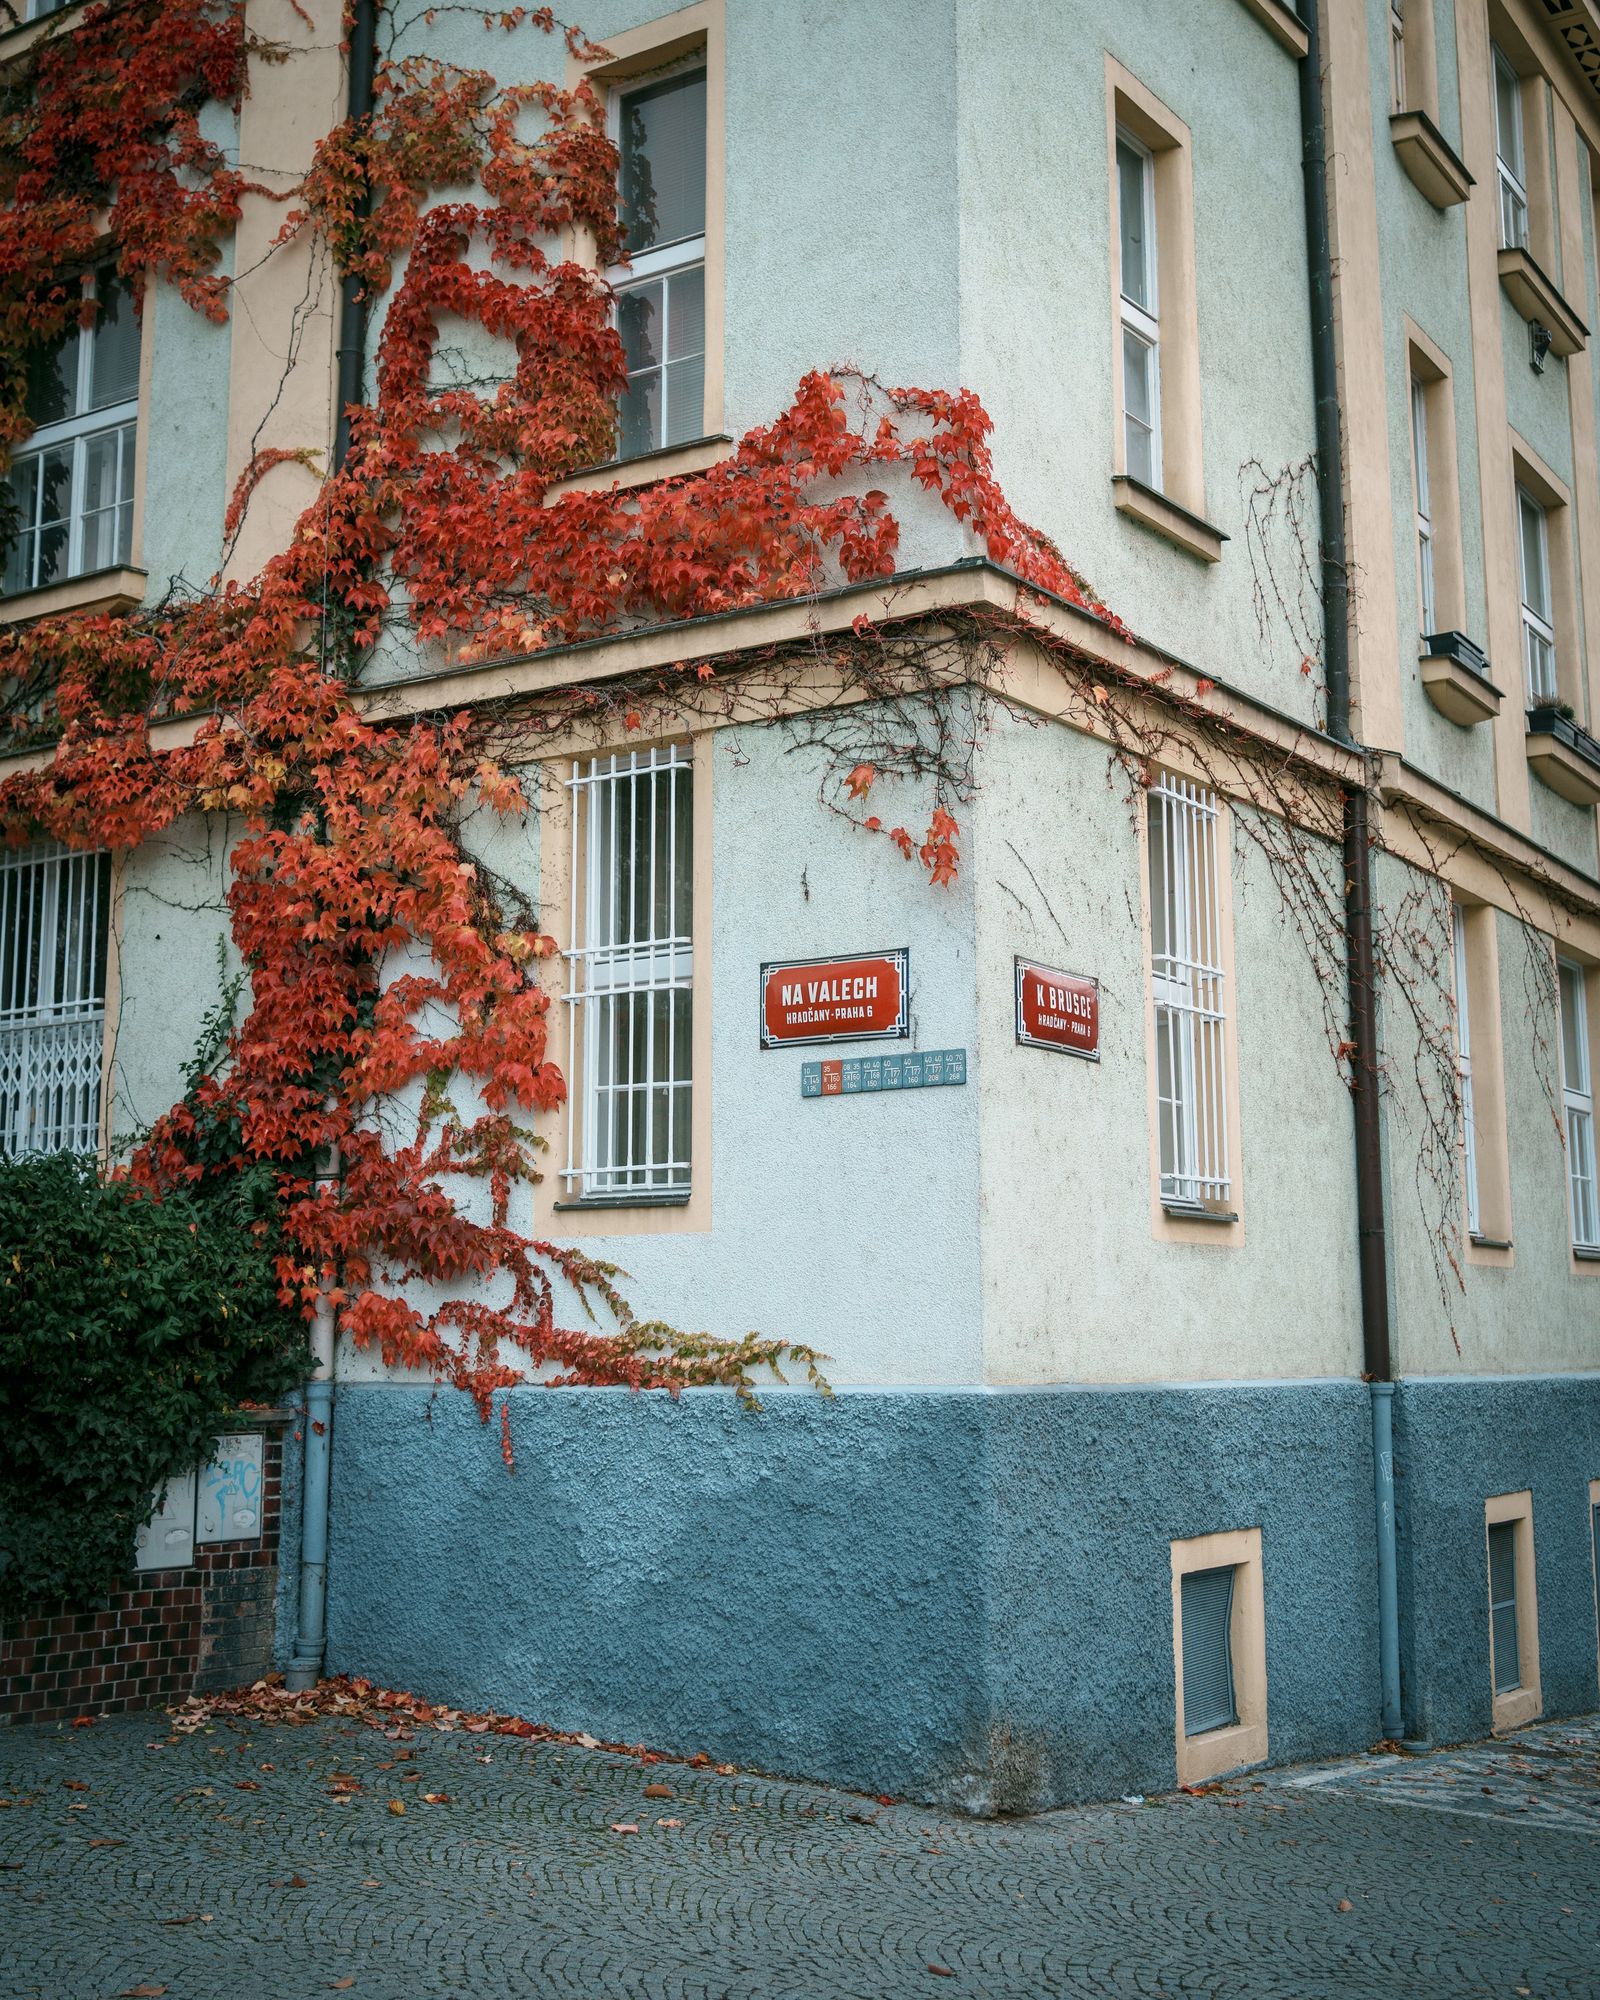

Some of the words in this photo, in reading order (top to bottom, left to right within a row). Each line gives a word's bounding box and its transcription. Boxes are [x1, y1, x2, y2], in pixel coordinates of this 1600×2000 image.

[782, 984, 803, 1006] NA
[808, 976, 878, 1004] VALECH
[1037, 984, 1045, 1007] K
[1049, 986, 1091, 1019] BRUSCE
[786, 1006, 830, 1024] HRADČANY
[835, 1006, 864, 1020] PRAHA
[867, 1005, 873, 1017] 6
[1038, 1013, 1067, 1030] HRADČANY
[1071, 1021, 1086, 1036] PRAHA
[914, 1067, 921, 1075] 77
